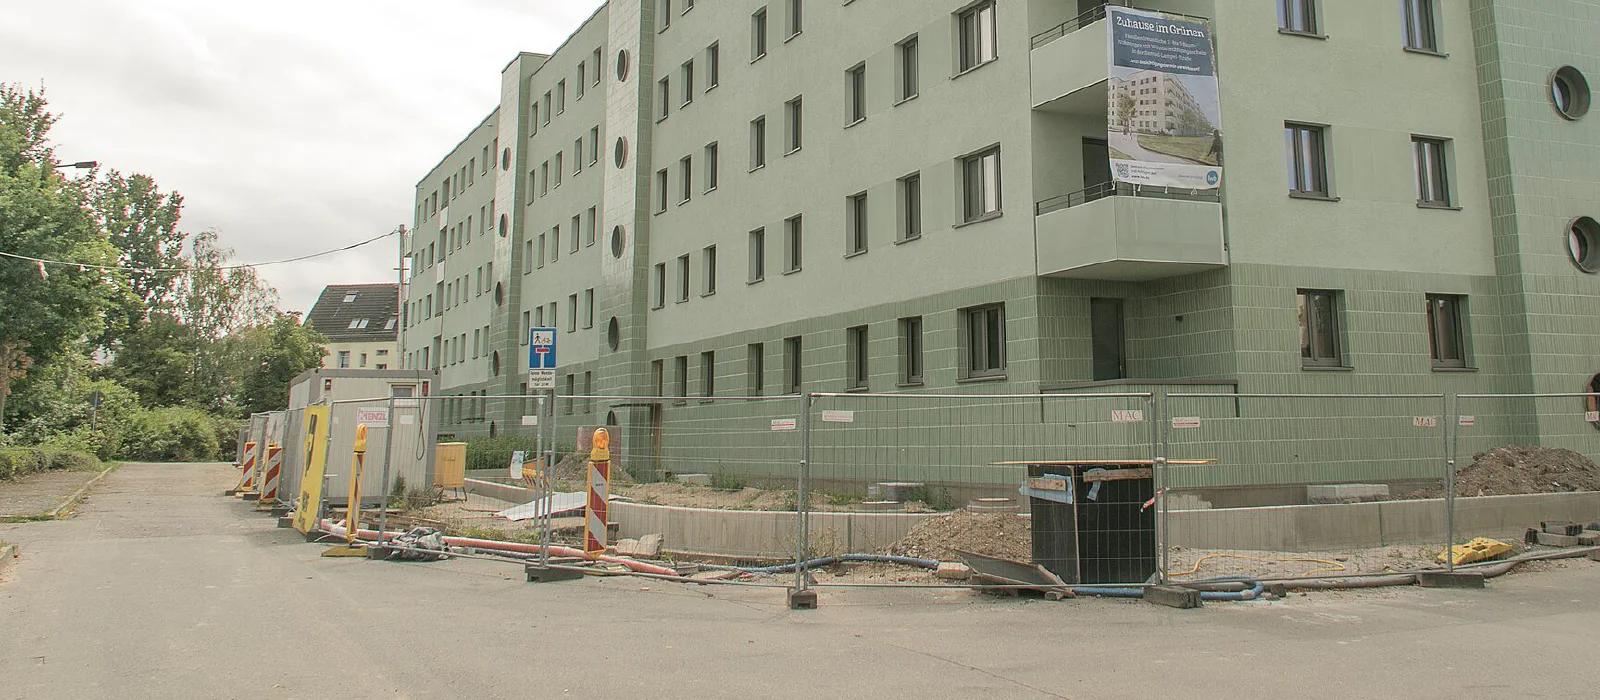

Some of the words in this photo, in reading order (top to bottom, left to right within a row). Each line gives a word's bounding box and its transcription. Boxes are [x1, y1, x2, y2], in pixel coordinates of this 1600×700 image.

[1116, 16, 1155, 32] Zuhause
[1155, 22, 1169, 34] im
[1169, 24, 1205, 38] Grünen
[1113, 410, 1141, 420] MAC
